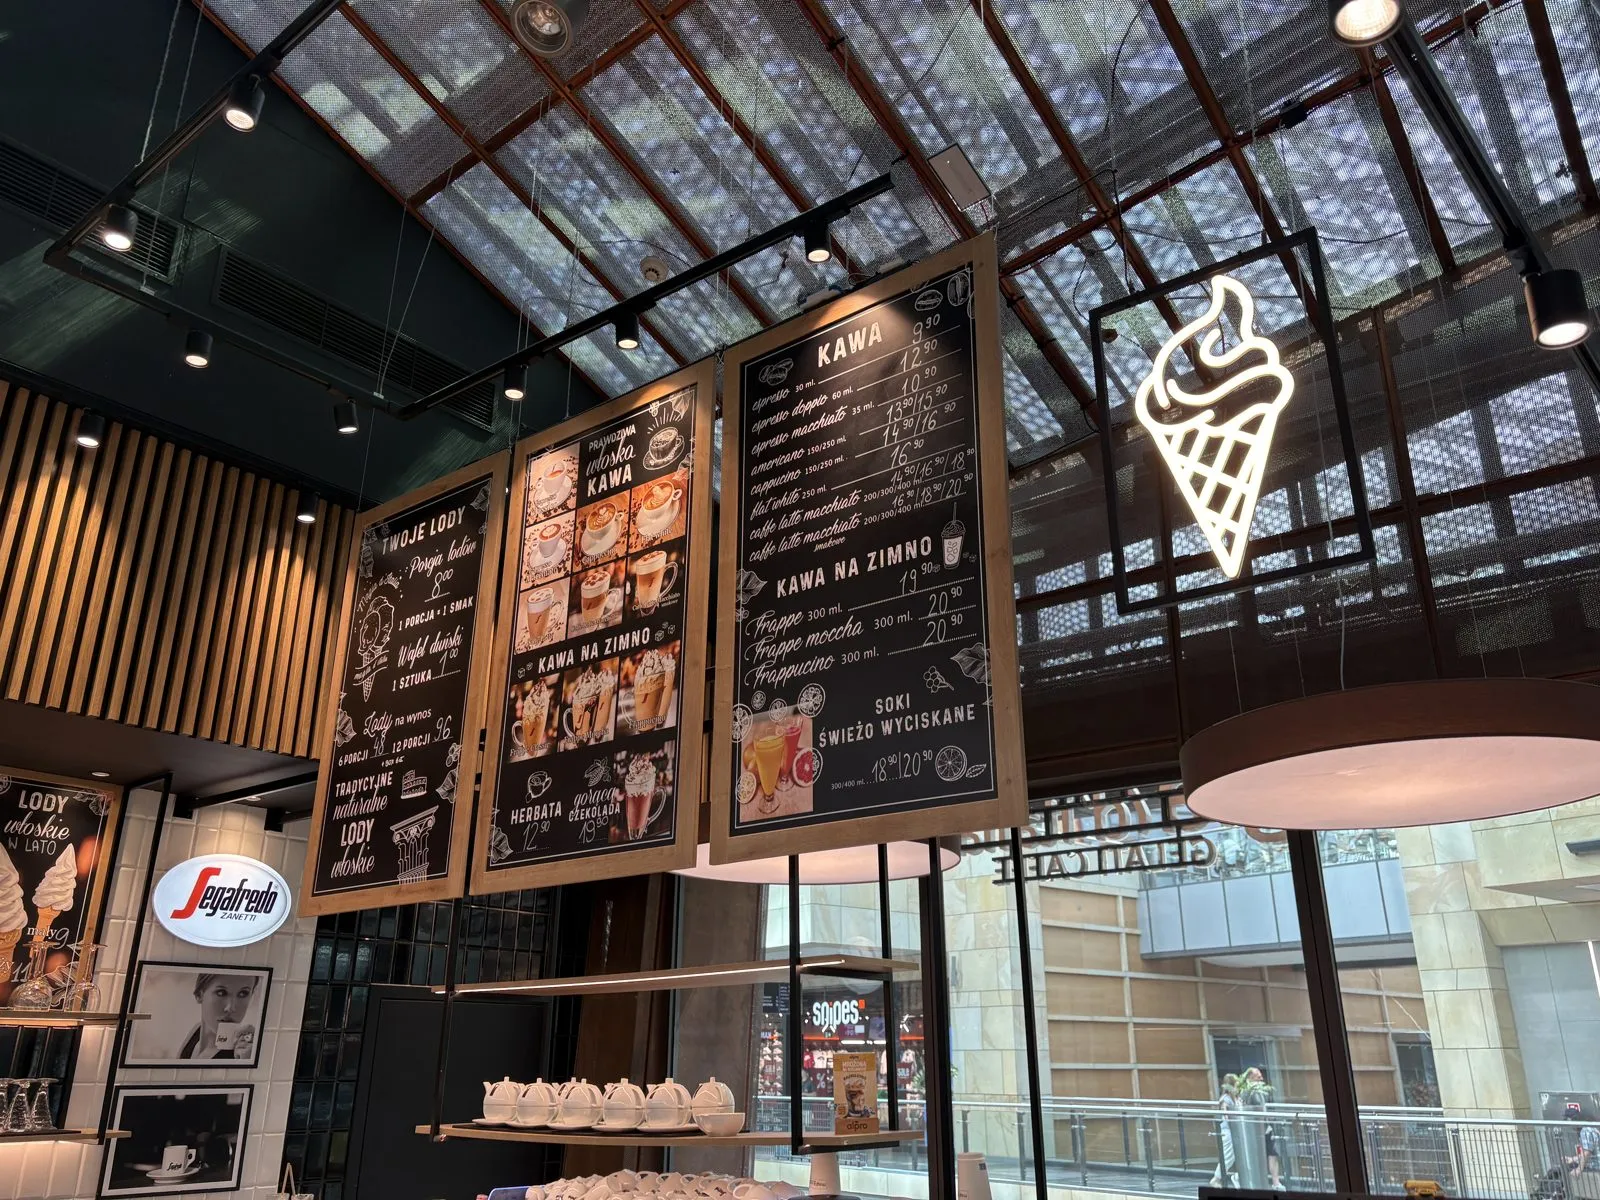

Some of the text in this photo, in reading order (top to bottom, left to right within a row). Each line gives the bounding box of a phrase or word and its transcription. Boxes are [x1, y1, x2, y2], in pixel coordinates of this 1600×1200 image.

[817, 322, 882, 368] KAWA
[751, 388, 790, 411] espresso
[795, 383, 804, 393] 30
[751, 410, 789, 435] espresso
[792, 393, 829, 419] doppio
[832, 390, 841, 400] 60
[751, 432, 789, 456] espresso
[791, 405, 848, 438] macchiato
[852, 406, 861, 416] 35
[750, 448, 805, 476] americano
[807, 439, 835, 456] 150/250
[587, 464, 632, 498] KAWA
[750, 468, 801, 497] cappucino
[805, 459, 833, 475] 150/250
[749, 518, 777, 540] caffe
[778, 509, 804, 530] latte
[803, 489, 862, 521] macchiato
[772, 488, 802, 510] white
[802, 489, 815, 499] 250
[382, 505, 466, 555] TWOJE LODY
[749, 540, 777, 562] caffe
[778, 532, 804, 553] latte
[803, 512, 862, 544] macchiato
[409, 535, 477, 579] Porcja lodów
[776, 535, 932, 598] KAWA NA ZIMNO
[405, 612, 435, 629] PORCJA
[450, 596, 473, 613] SMAK
[744, 609, 804, 637] Frappe
[807, 610, 826, 622] 300
[430, 625, 464, 655] duński
[538, 627, 650, 674] KAWA NA ZIMNO
[744, 635, 803, 664] Frappe
[806, 615, 864, 647] moccha
[874, 617, 894, 630] 300
[399, 669, 432, 690] SZTUKA
[744, 654, 835, 689] Frappucino
[841, 653, 860, 665] 300
[875, 693, 910, 715] SOKI
[363, 709, 432, 737] Lody na wynos
[818, 704, 976, 748] ŚWIEŻO WYCISKANE
[338, 758, 343, 767] 6
[344, 750, 368, 765] PORCJI
[392, 741, 401, 754] 12
[403, 733, 430, 751] PORCJI
[434, 715, 452, 742] 96
[335, 771, 393, 797] TRADYCYJNE
[573, 786, 617, 812] gorąca
[18, 790, 69, 813] LODY
[332, 788, 388, 821] naturalne
[511, 801, 562, 825] HERBATA
[568, 802, 621, 823] CZEKOLADA
[4, 811, 70, 840] włoskie
[340, 818, 374, 847] LODY
[8, 837, 57, 855] W LATO
[170, 867, 278, 919] Segafredo
[220, 912, 256, 922] ZANETTI
[847, 1121, 867, 1131] alpro
